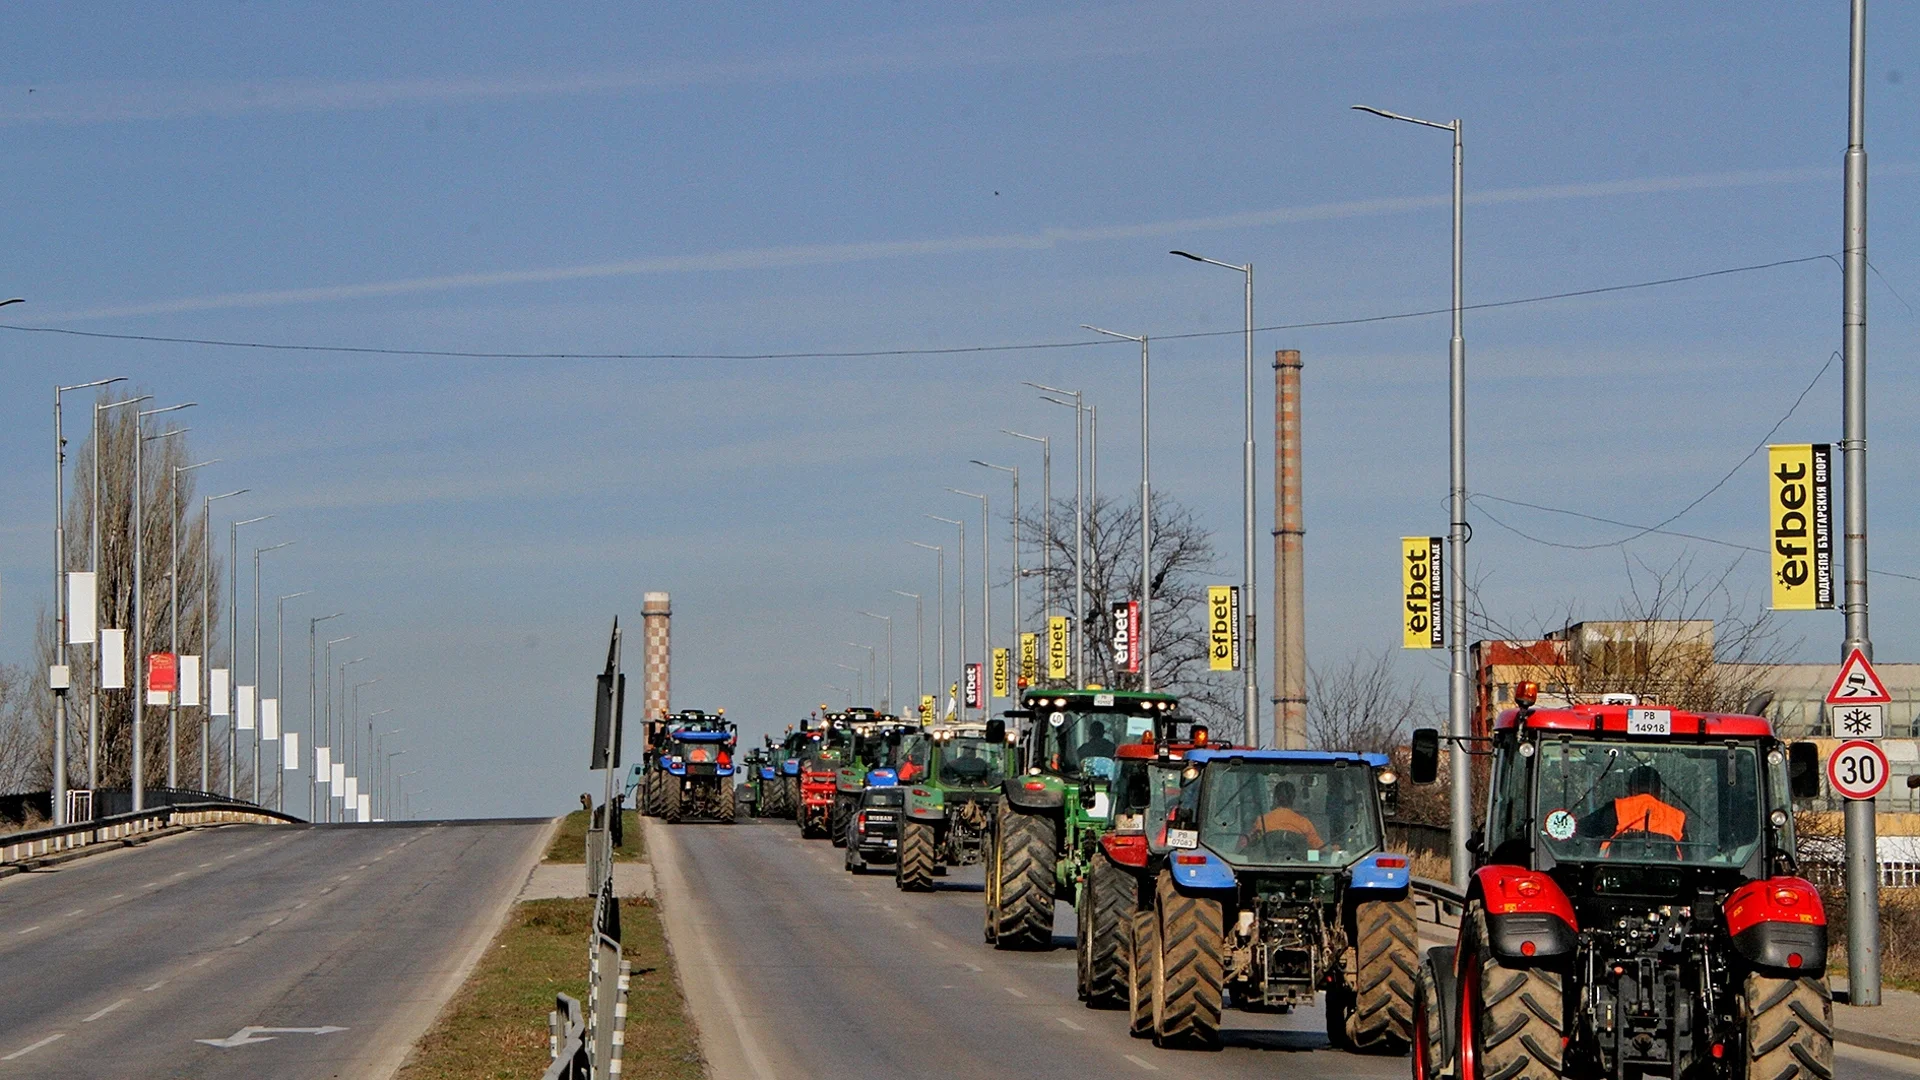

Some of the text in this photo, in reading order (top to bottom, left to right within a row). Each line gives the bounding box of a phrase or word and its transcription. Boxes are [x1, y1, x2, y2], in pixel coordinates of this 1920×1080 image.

[1774, 462, 1808, 588] efbet
[1815, 451, 1830, 602] ПОДКРЕПЯ БЪЛГАРСКИЯ СПОРТ
[1431, 543, 1440, 592] НАВСЯКЪДЕ
[1406, 549, 1428, 633] efbet
[1113, 608, 1128, 664] efbet
[1211, 595, 1228, 659] efbet
[1432, 601, 1441, 642] ТРЪПКАТА
[1023, 639, 1034, 679] efbet
[1051, 623, 1063, 670] efbet
[966, 667, 976, 704] efbet
[994, 653, 1004, 691] efbet
[1052, 714, 1062, 724] 40
[1635, 723, 1665, 733] 14918
[1643, 711, 1656, 720] PB
[1841, 755, 1875, 785] 30
[1177, 831, 1188, 839] PB
